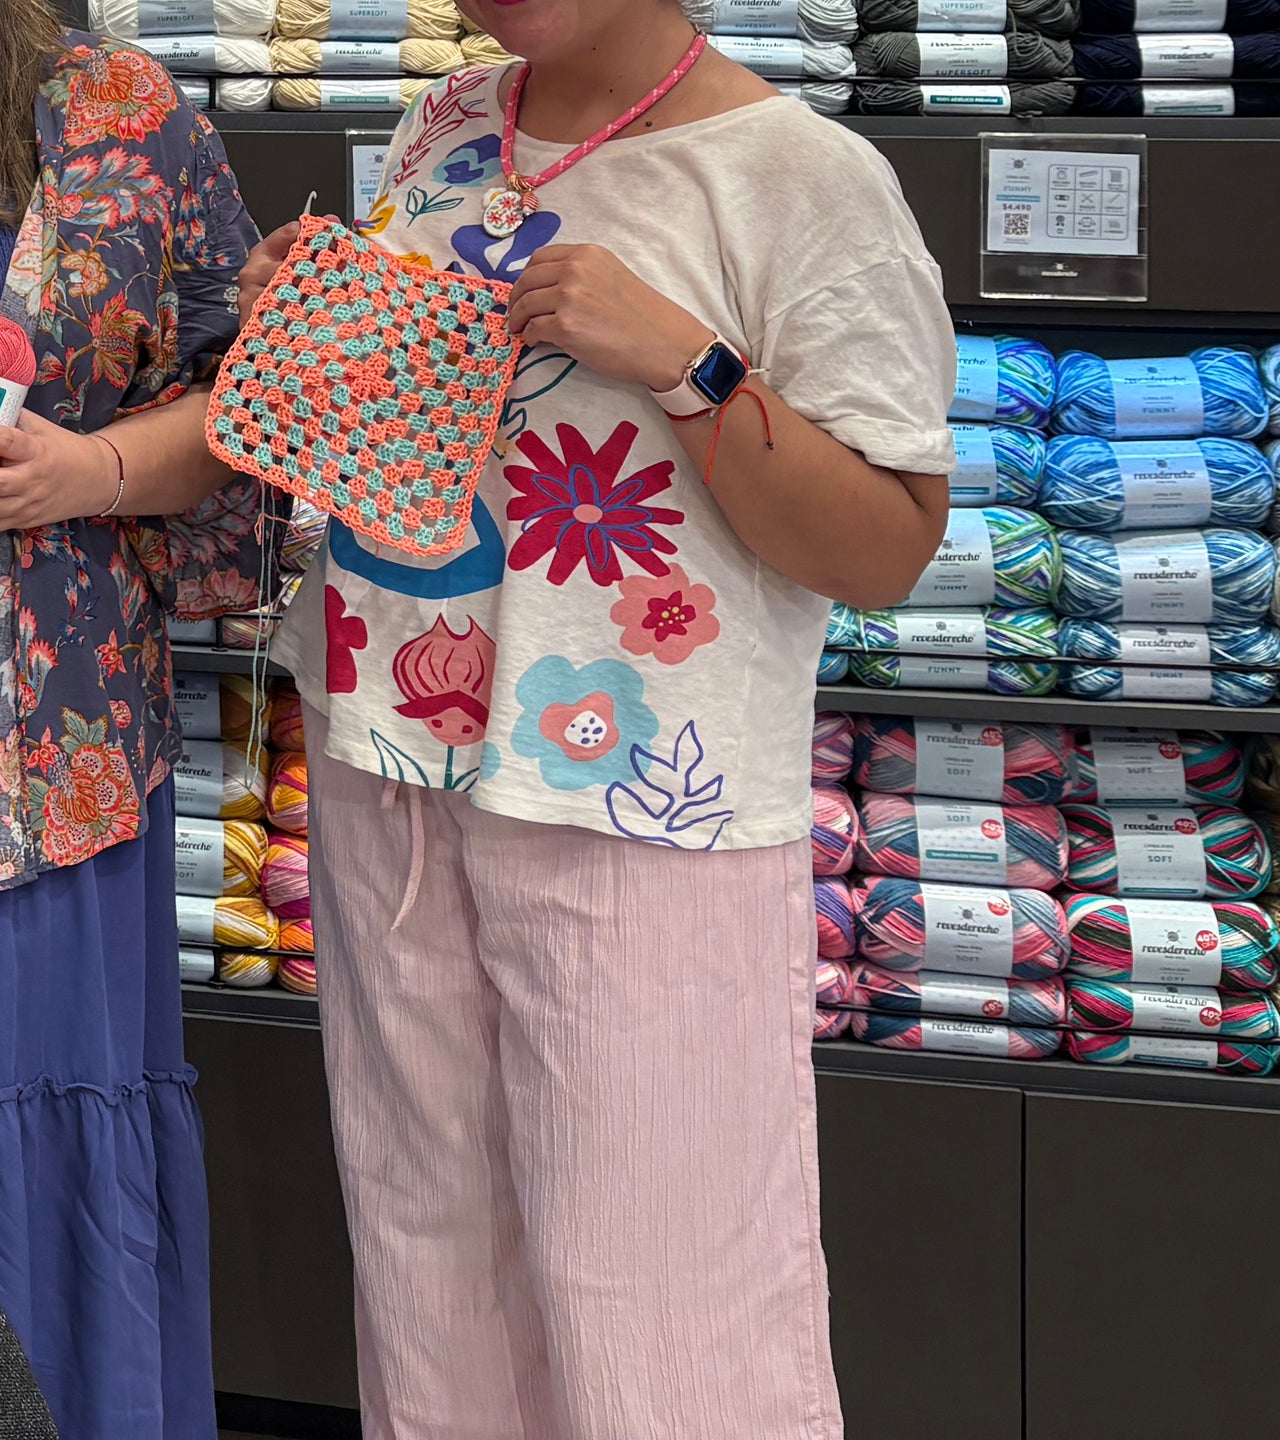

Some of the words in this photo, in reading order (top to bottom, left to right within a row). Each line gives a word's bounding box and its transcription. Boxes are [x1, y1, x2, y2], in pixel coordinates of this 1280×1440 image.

[1148, 855, 1172, 863] SOFT
[1197, 934, 1218, 943] 40%
[1202, 1009, 1222, 1020] 40%
